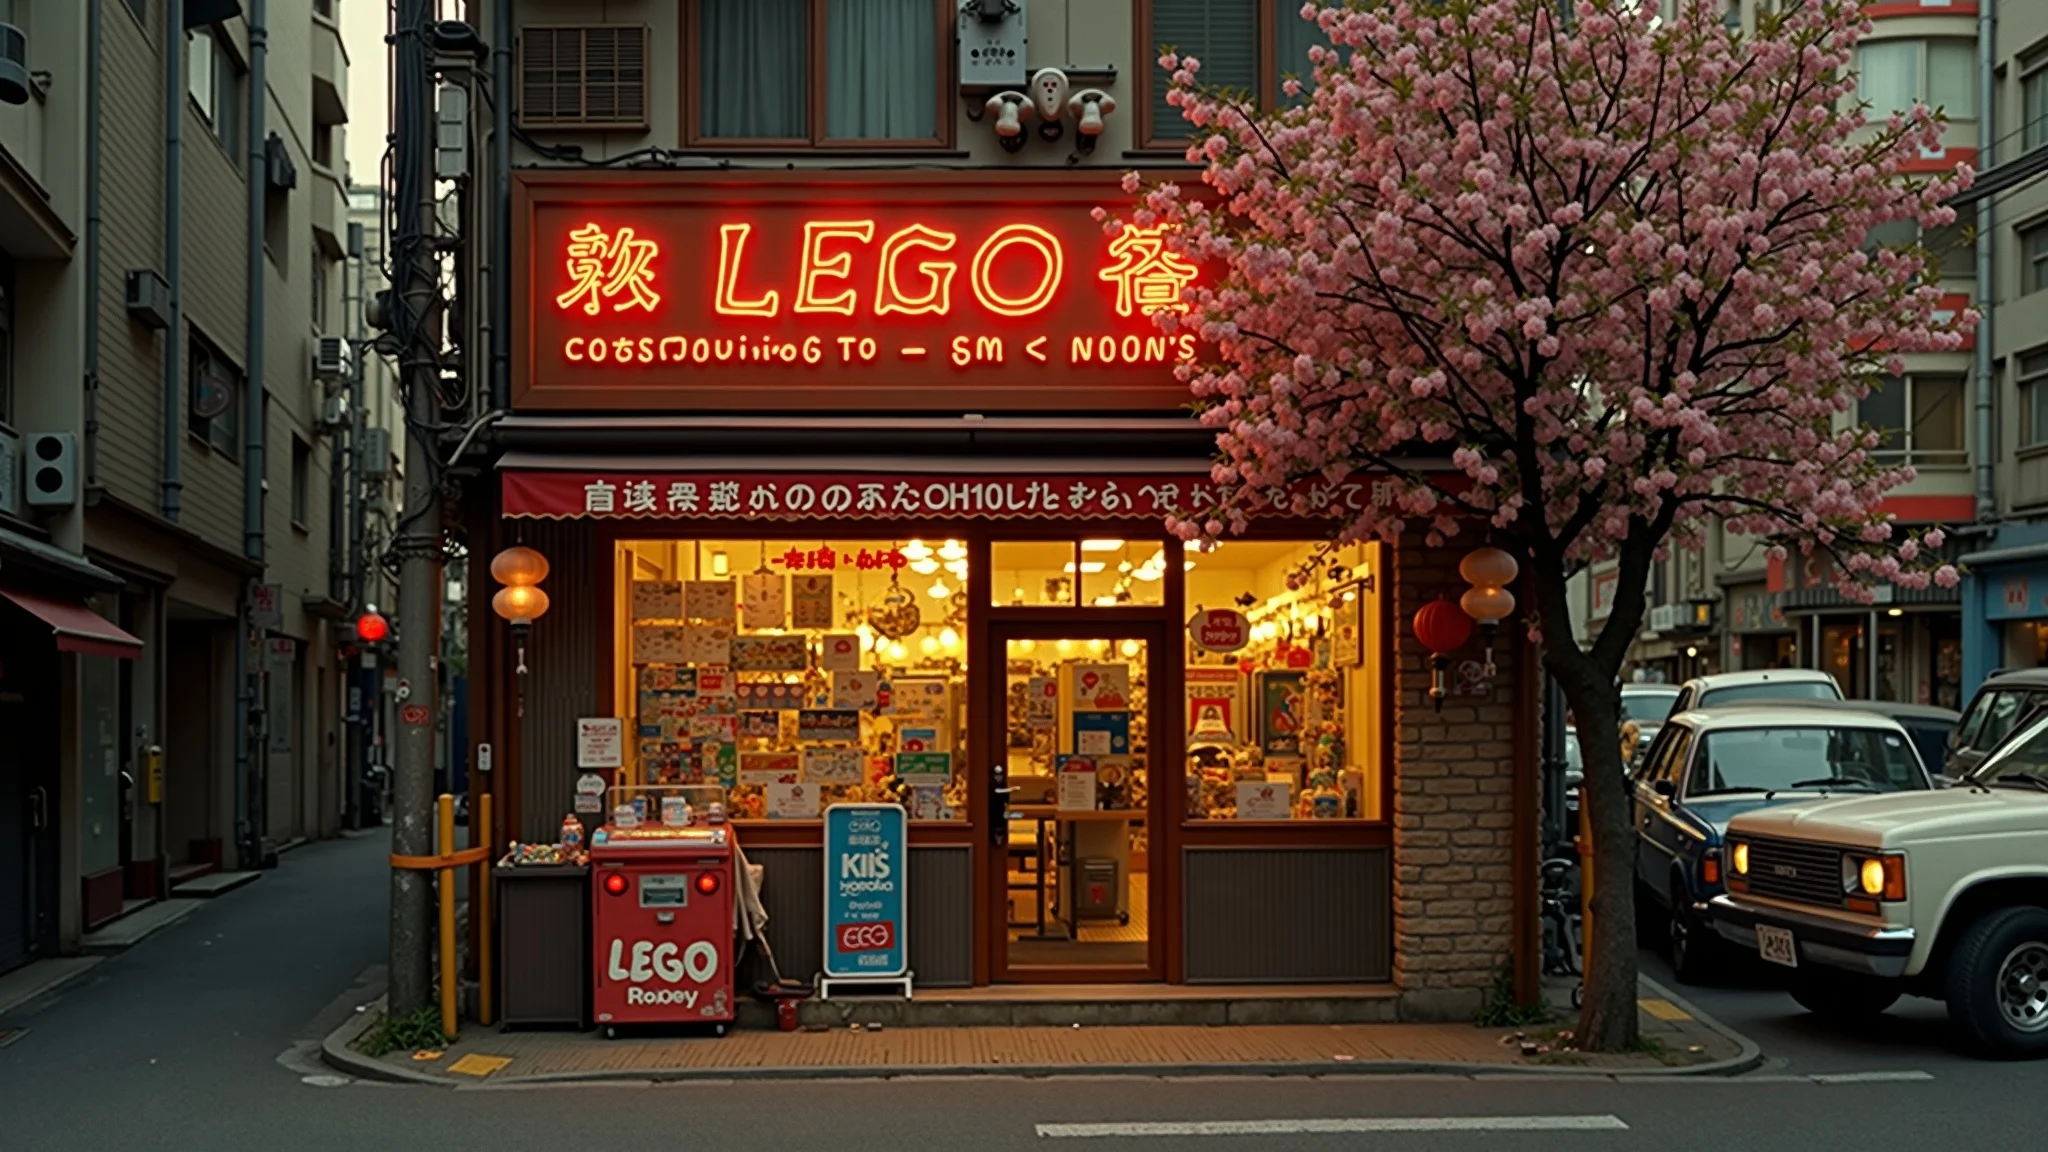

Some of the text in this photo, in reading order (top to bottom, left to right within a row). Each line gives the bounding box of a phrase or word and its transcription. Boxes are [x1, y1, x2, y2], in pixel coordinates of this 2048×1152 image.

[715, 219, 1064, 317] LEGO
[837, 336, 877, 361] TO
[608, 938, 719, 984] LEGO
